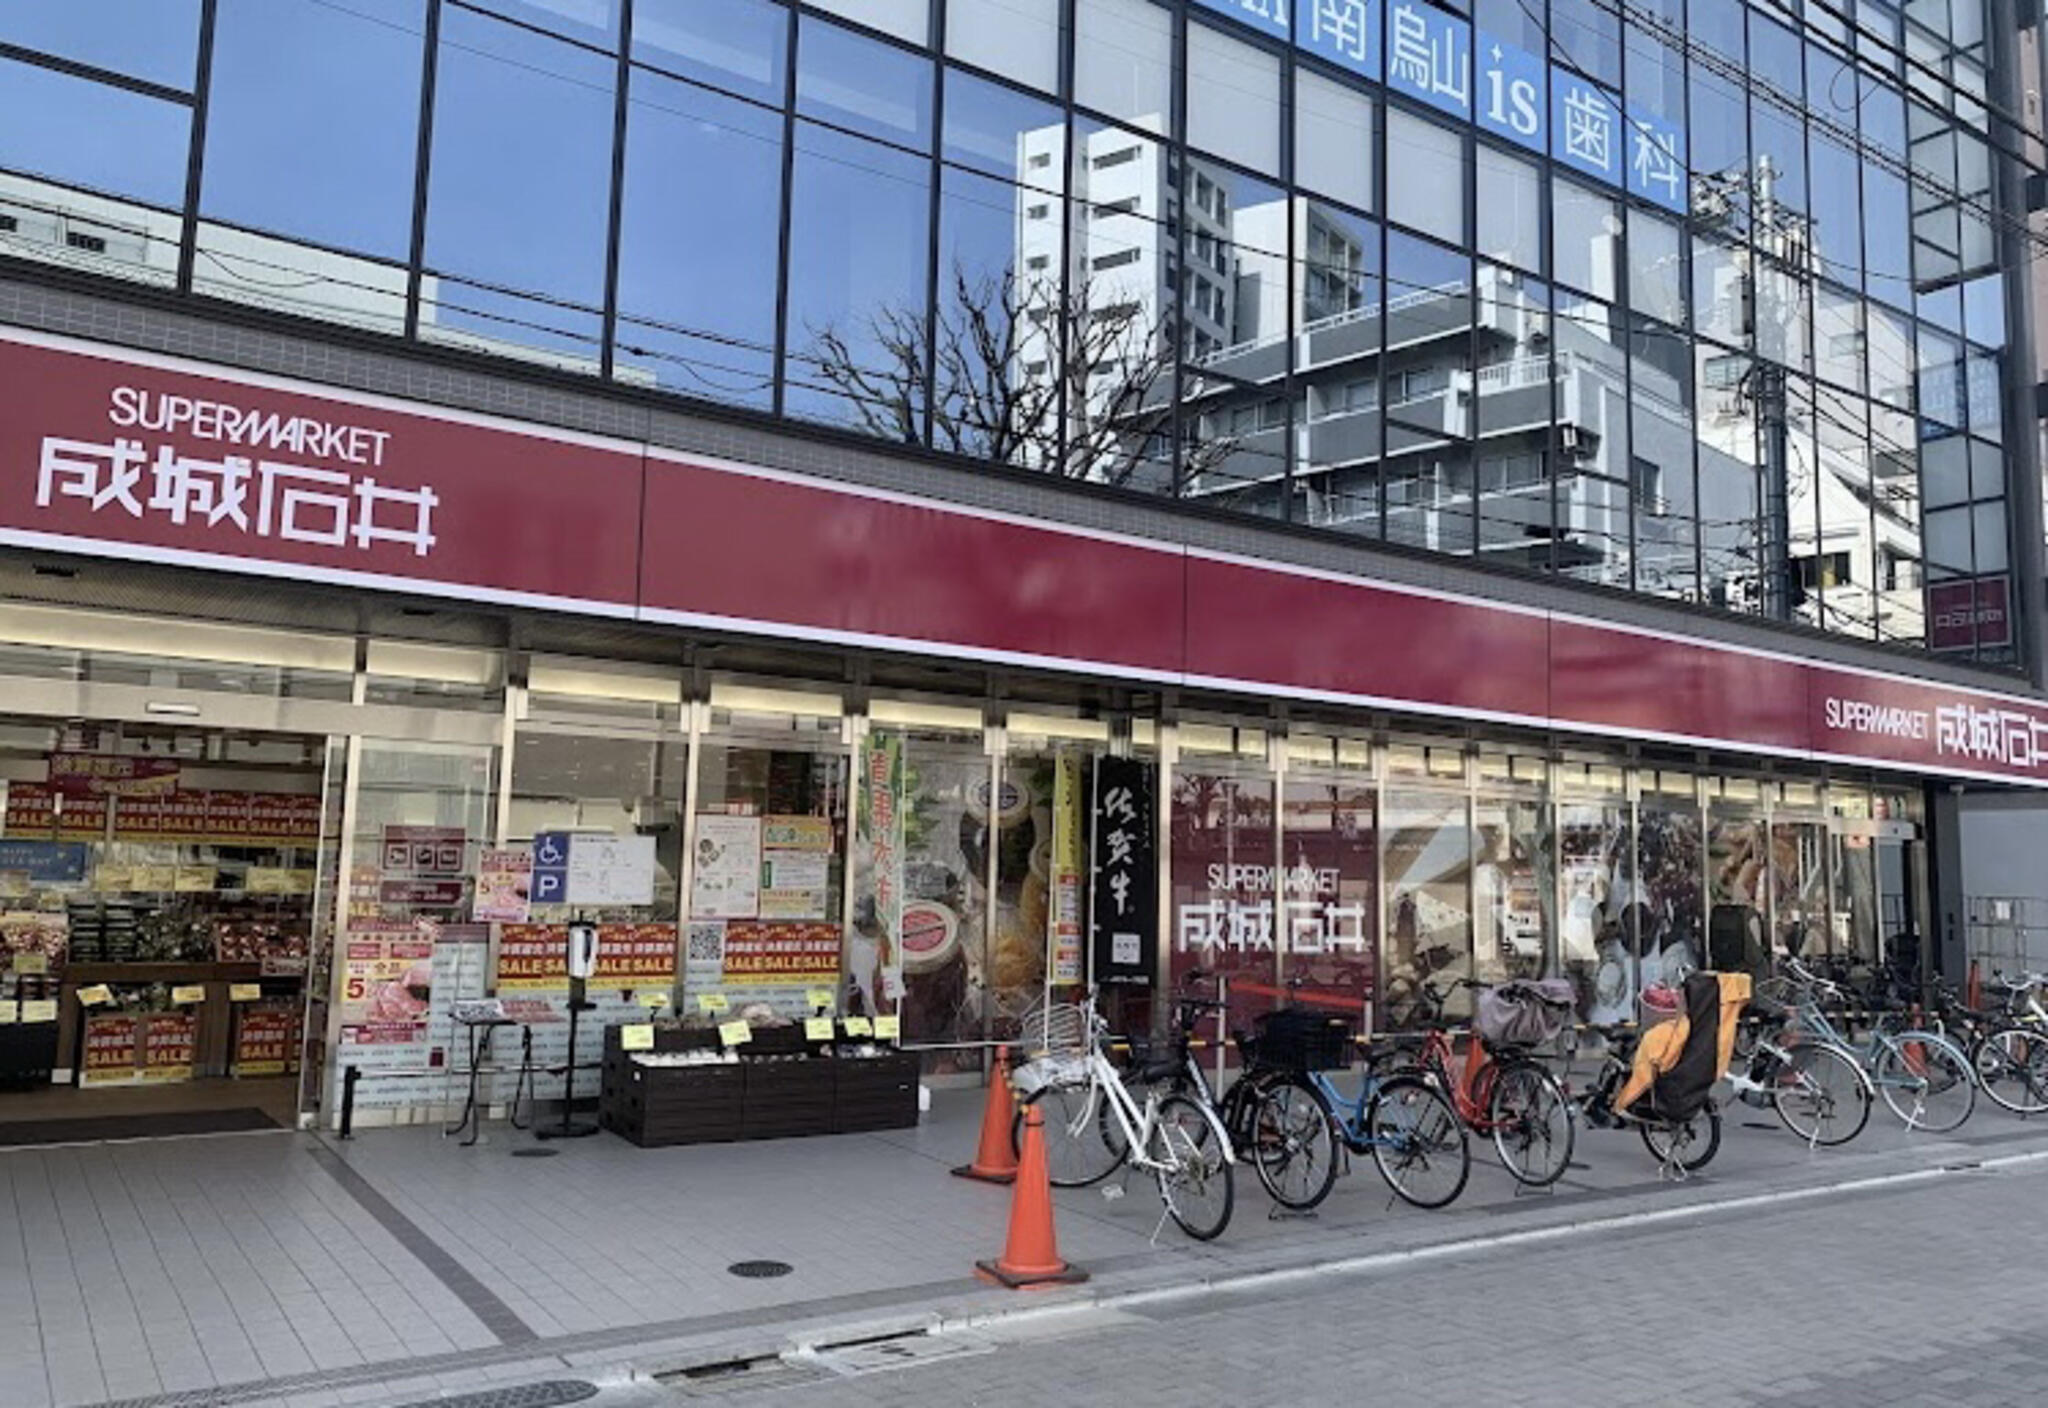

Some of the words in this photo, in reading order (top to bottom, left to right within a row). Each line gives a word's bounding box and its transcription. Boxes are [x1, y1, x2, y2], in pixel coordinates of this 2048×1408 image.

[1487, 44, 1538, 134] is
[1564, 88, 1680, 199] 歯科
[108, 386, 391, 466] SUPERMARKET
[35, 436, 440, 556] 成城石井
[1825, 697, 1929, 741] SUPERMARKET
[1104, 786, 1137, 916] 佐賀牛
[538, 875, 559, 898] P
[1179, 899, 1365, 953] 成城石井
[499, 957, 542, 974] SALE
[545, 958, 567, 974] SA
[633, 956, 674, 972] SALE
[726, 956, 761, 970] SALE
[765, 956, 800, 970] SALE
[804, 955, 838, 970] SALE
[347, 977, 364, 999] 5
[88, 1050, 133, 1065] SALE
[147, 1048, 191, 1064] SALE
[240, 1043, 283, 1059] SALE
